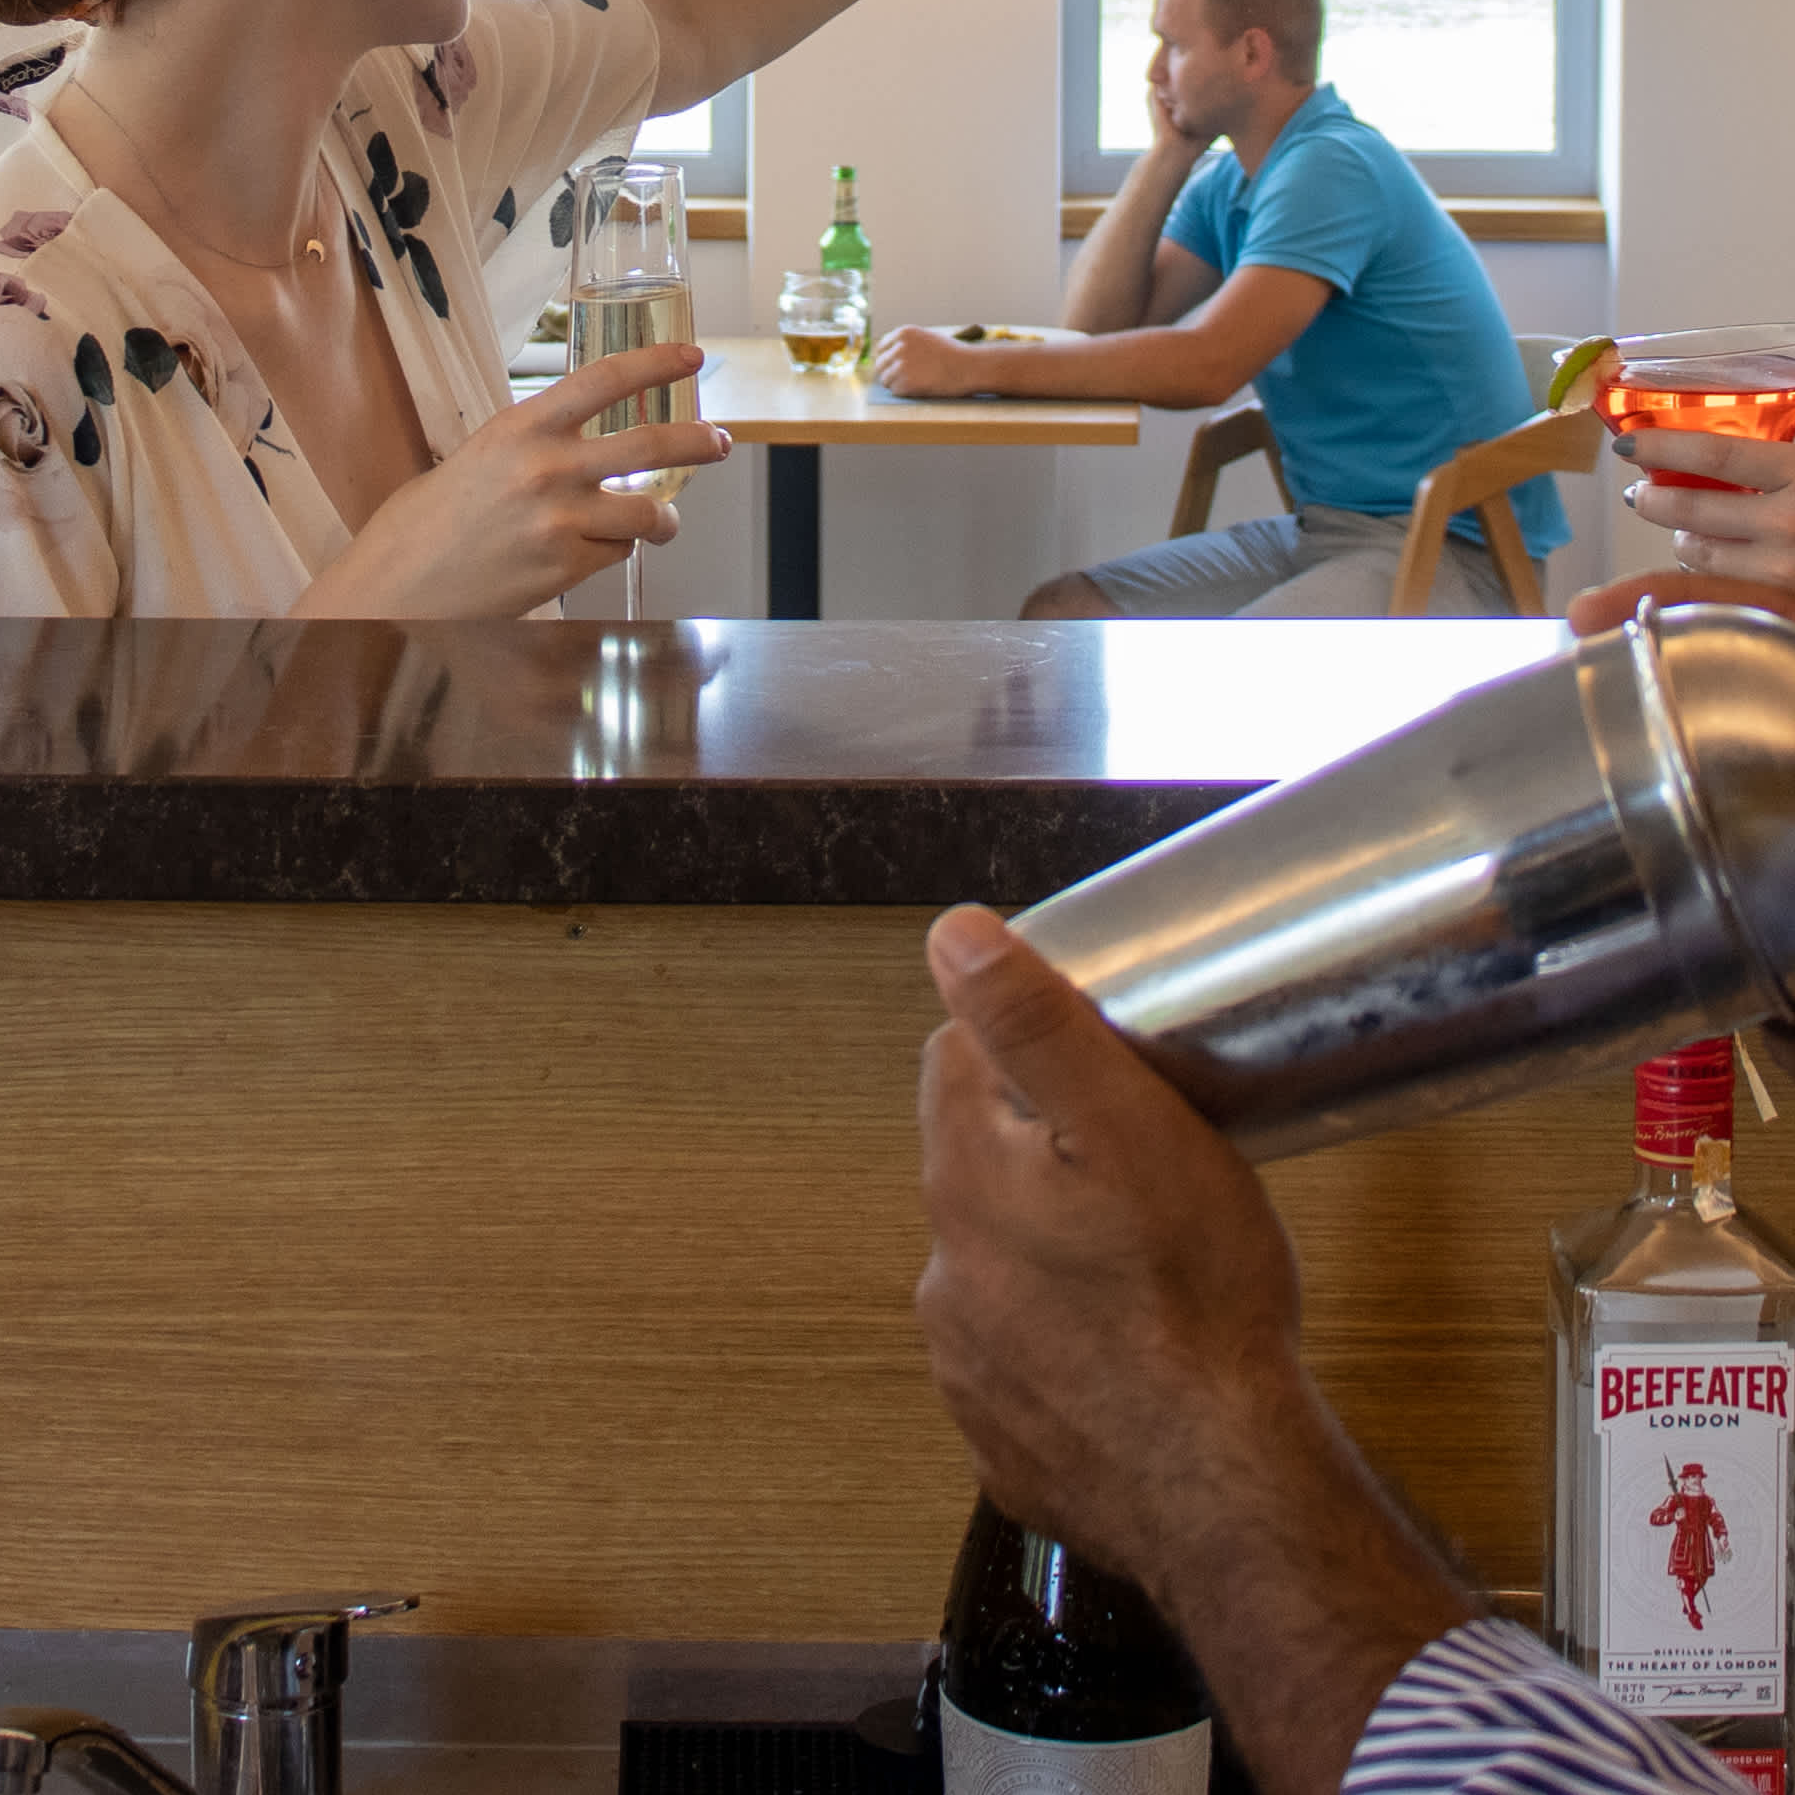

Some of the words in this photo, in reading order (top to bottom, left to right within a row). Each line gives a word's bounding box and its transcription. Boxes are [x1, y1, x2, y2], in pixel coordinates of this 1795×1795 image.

[1601, 1365, 1788, 1420] BEEFEATER
[1649, 1413, 1740, 1428] LONDON
[1654, 1648, 1714, 1656] DISTILLED
[1608, 1661, 1634, 1671] THE
[1640, 1660, 1686, 1671] HEART
[1692, 1660, 1710, 1670] OF
[1716, 1659, 1777, 1670] LONDON
